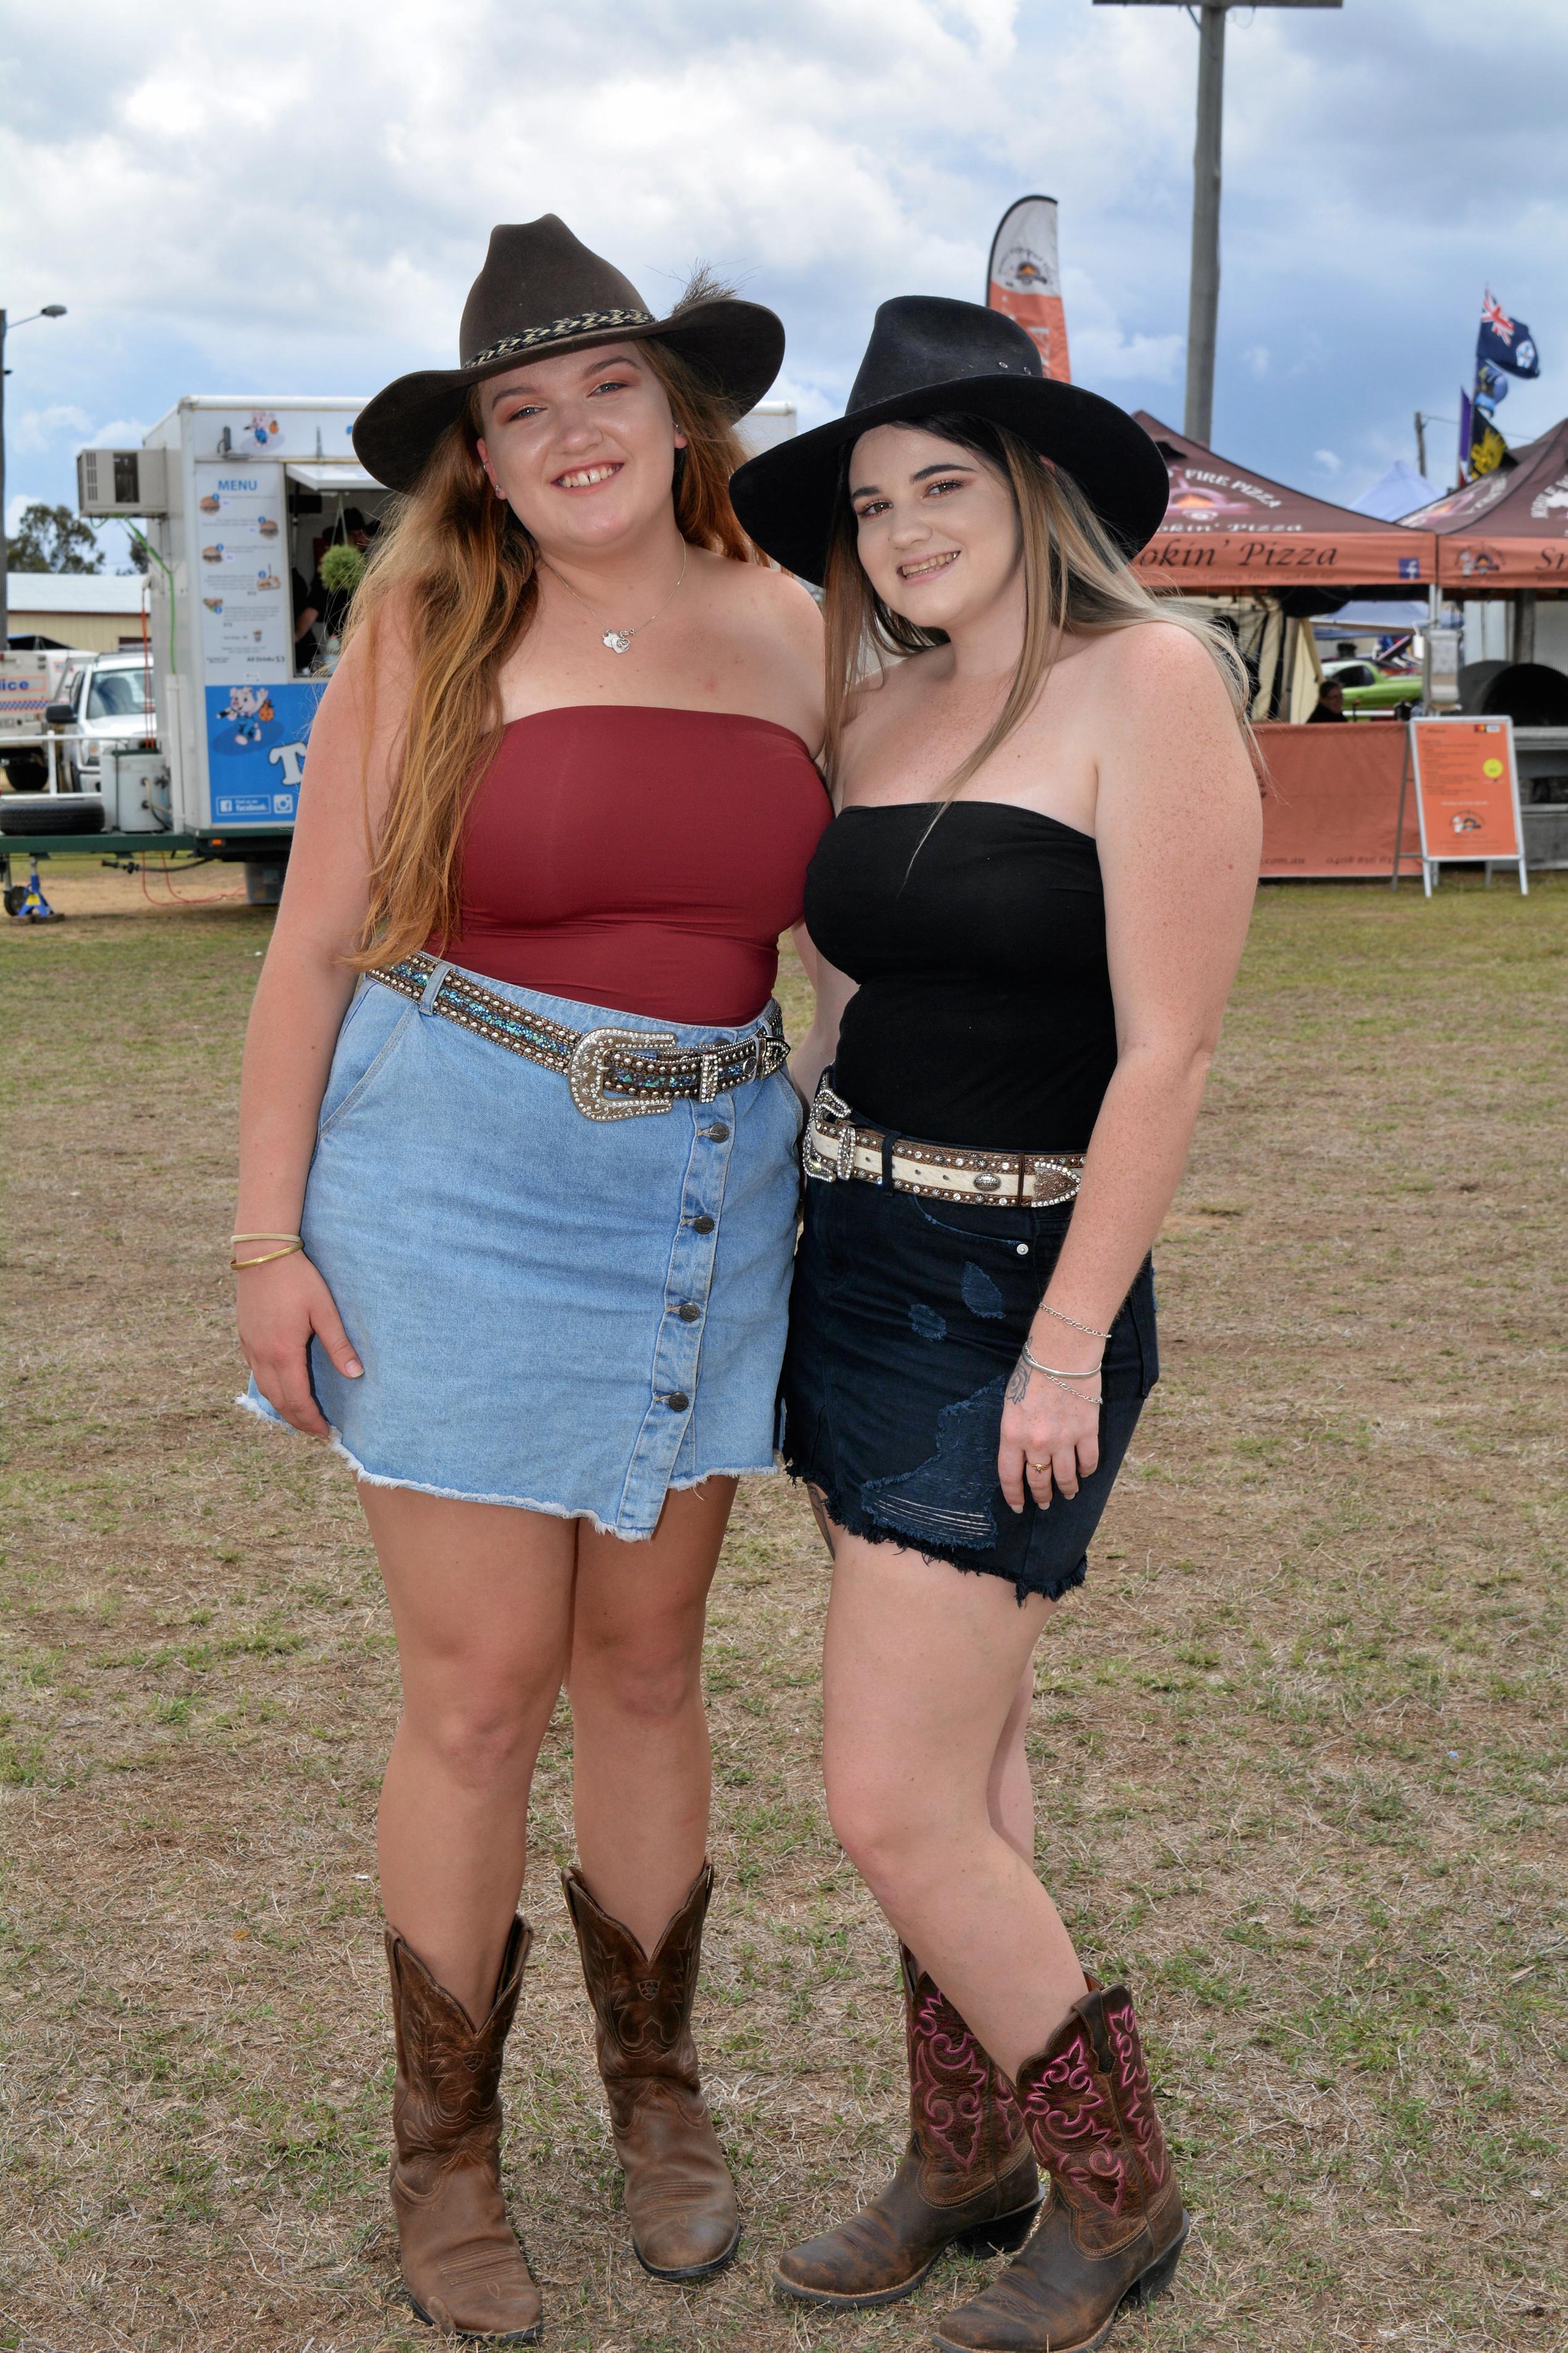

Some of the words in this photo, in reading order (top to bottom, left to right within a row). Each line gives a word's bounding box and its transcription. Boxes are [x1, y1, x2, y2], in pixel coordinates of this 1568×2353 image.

[218, 480, 258, 491] MENU
[1184, 468, 1231, 487] FIRE
[1230, 479, 1283, 509] PIZZA
[1238, 541, 1339, 567] Pizza
[0, 679, 29, 690] ice
